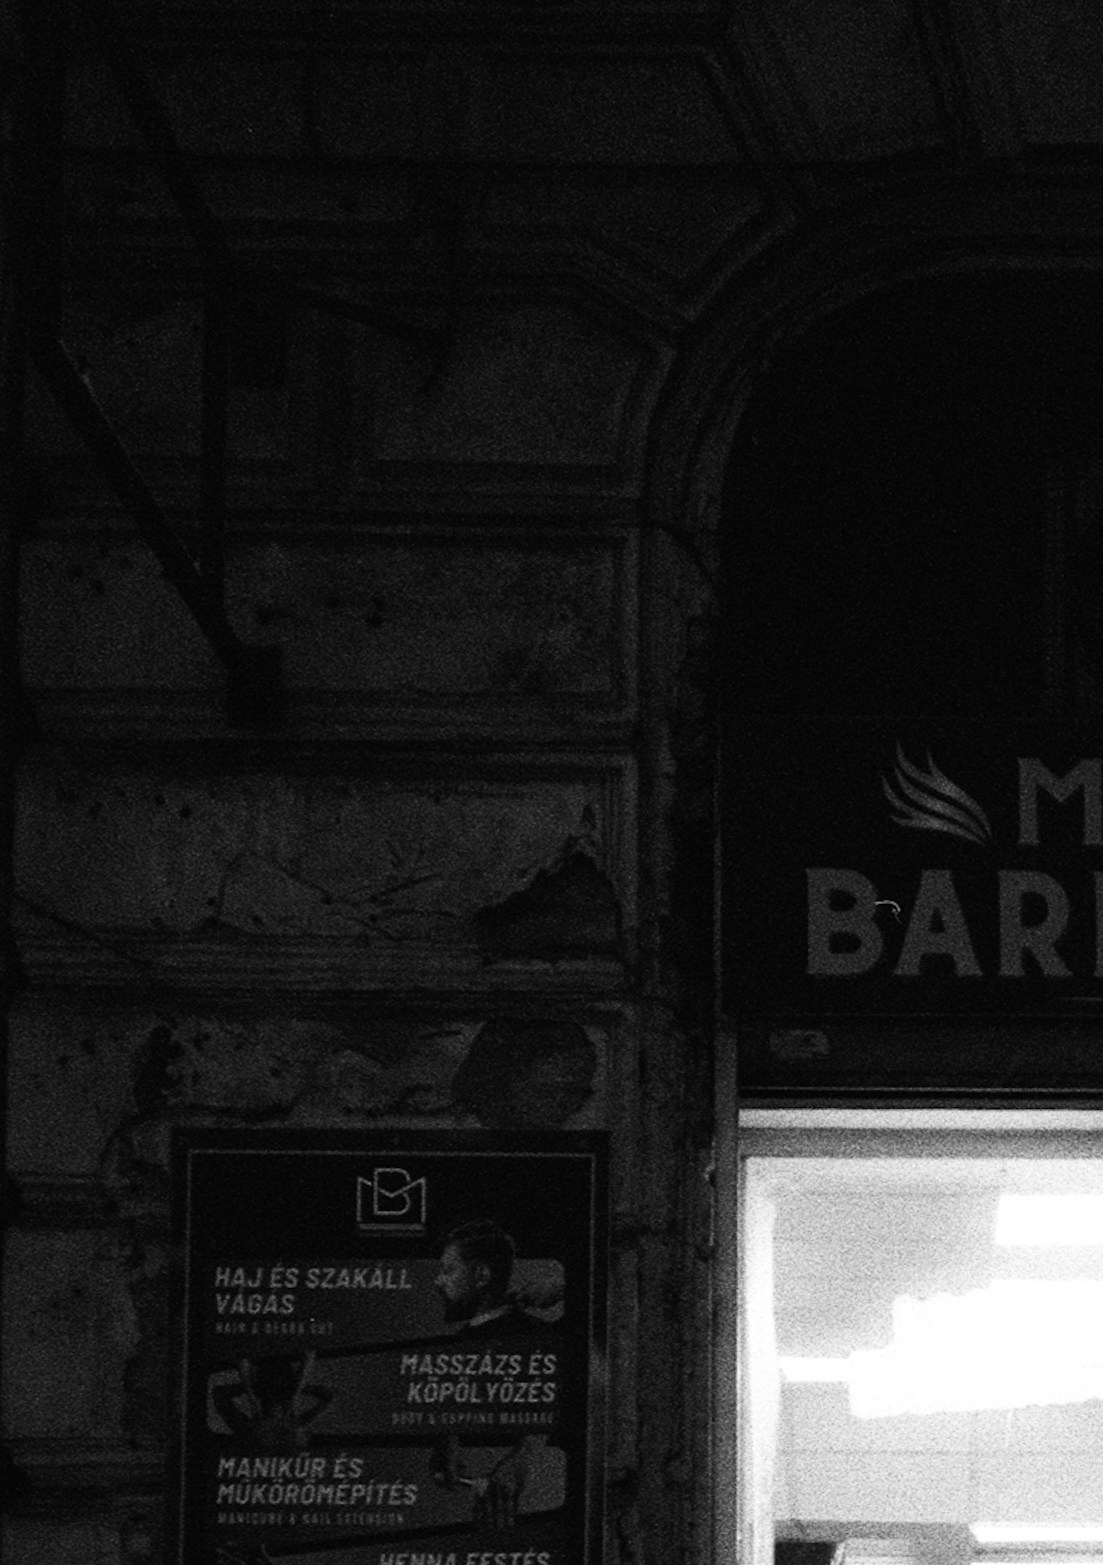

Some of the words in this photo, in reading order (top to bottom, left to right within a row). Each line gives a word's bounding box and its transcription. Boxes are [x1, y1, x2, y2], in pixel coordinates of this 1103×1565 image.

[214, 1266, 262, 1288] HAJ
[269, 1265, 299, 1288] ÉS
[305, 1264, 412, 1290] SZAKÁLL
[215, 1290, 295, 1315] VÁGÁS
[399, 1350, 522, 1376] MASSZÁZS
[528, 1349, 557, 1374] ÉS
[407, 1377, 556, 1403] KÖPÖLYÖZÉS
[332, 1454, 365, 1478] ÉS
